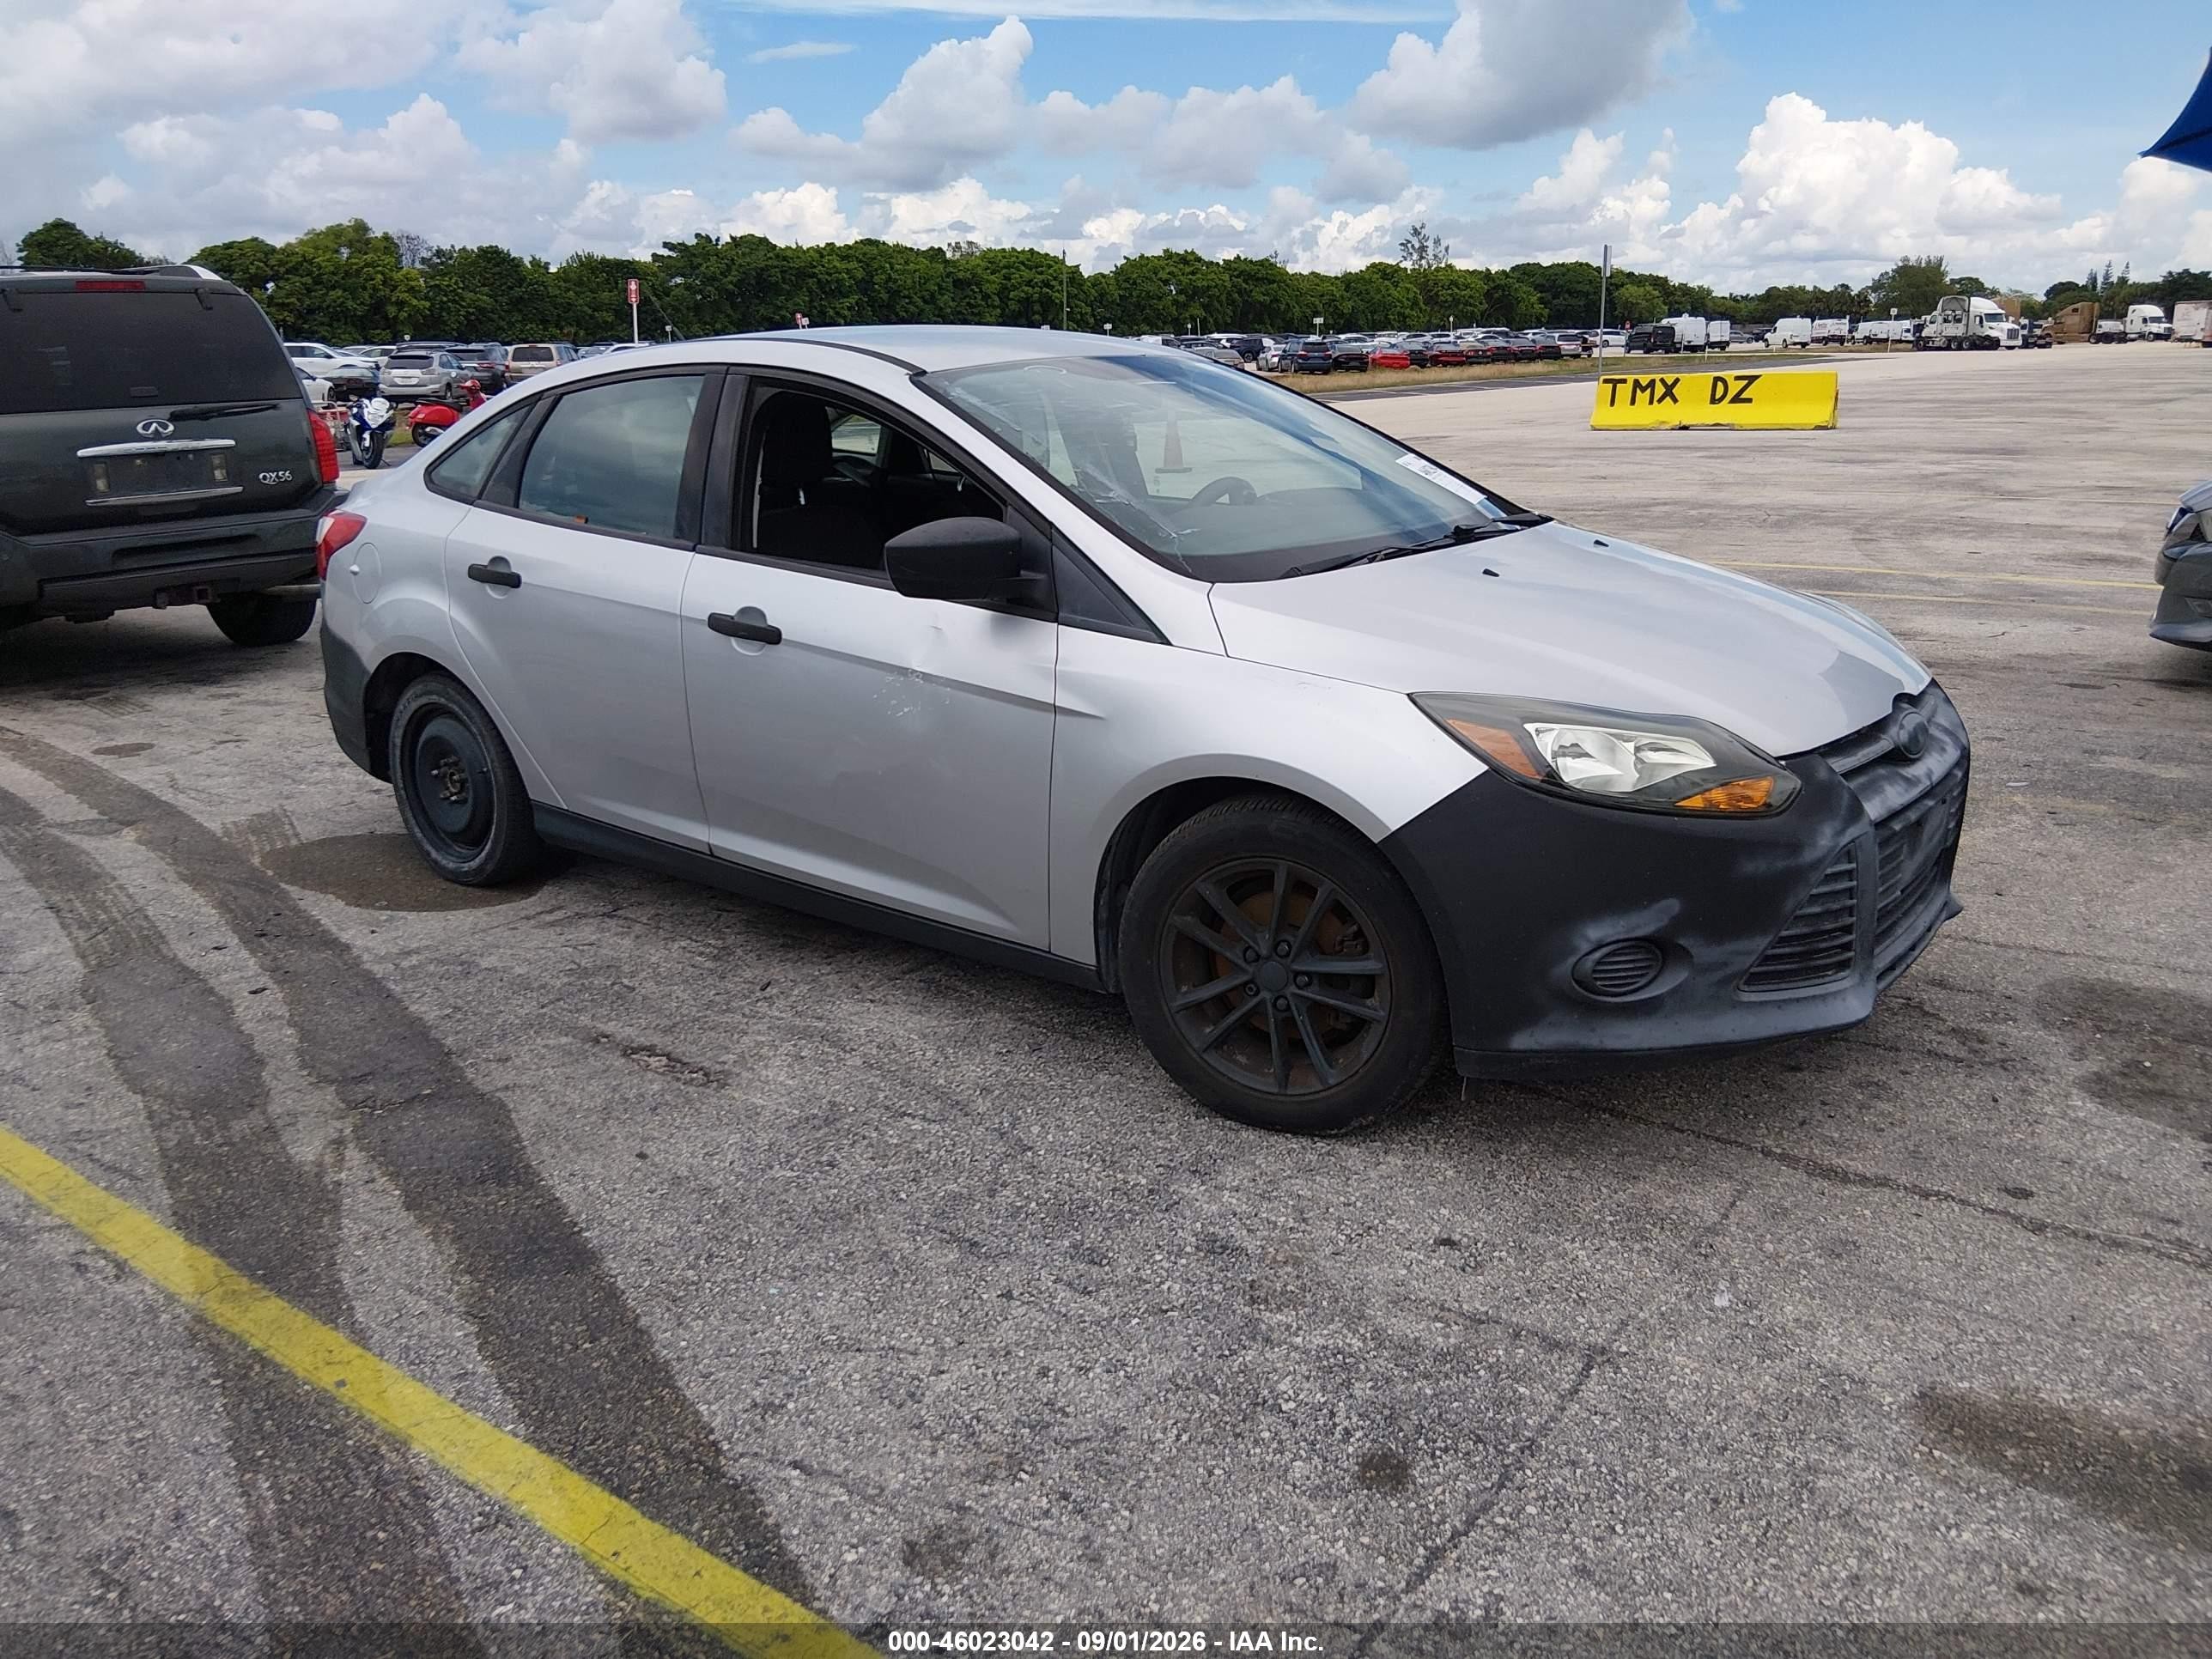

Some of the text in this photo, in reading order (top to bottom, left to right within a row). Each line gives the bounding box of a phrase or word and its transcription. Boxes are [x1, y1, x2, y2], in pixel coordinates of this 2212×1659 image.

[1601, 374, 1763, 407] TMX DZ
[258, 470, 293, 485] QX56
